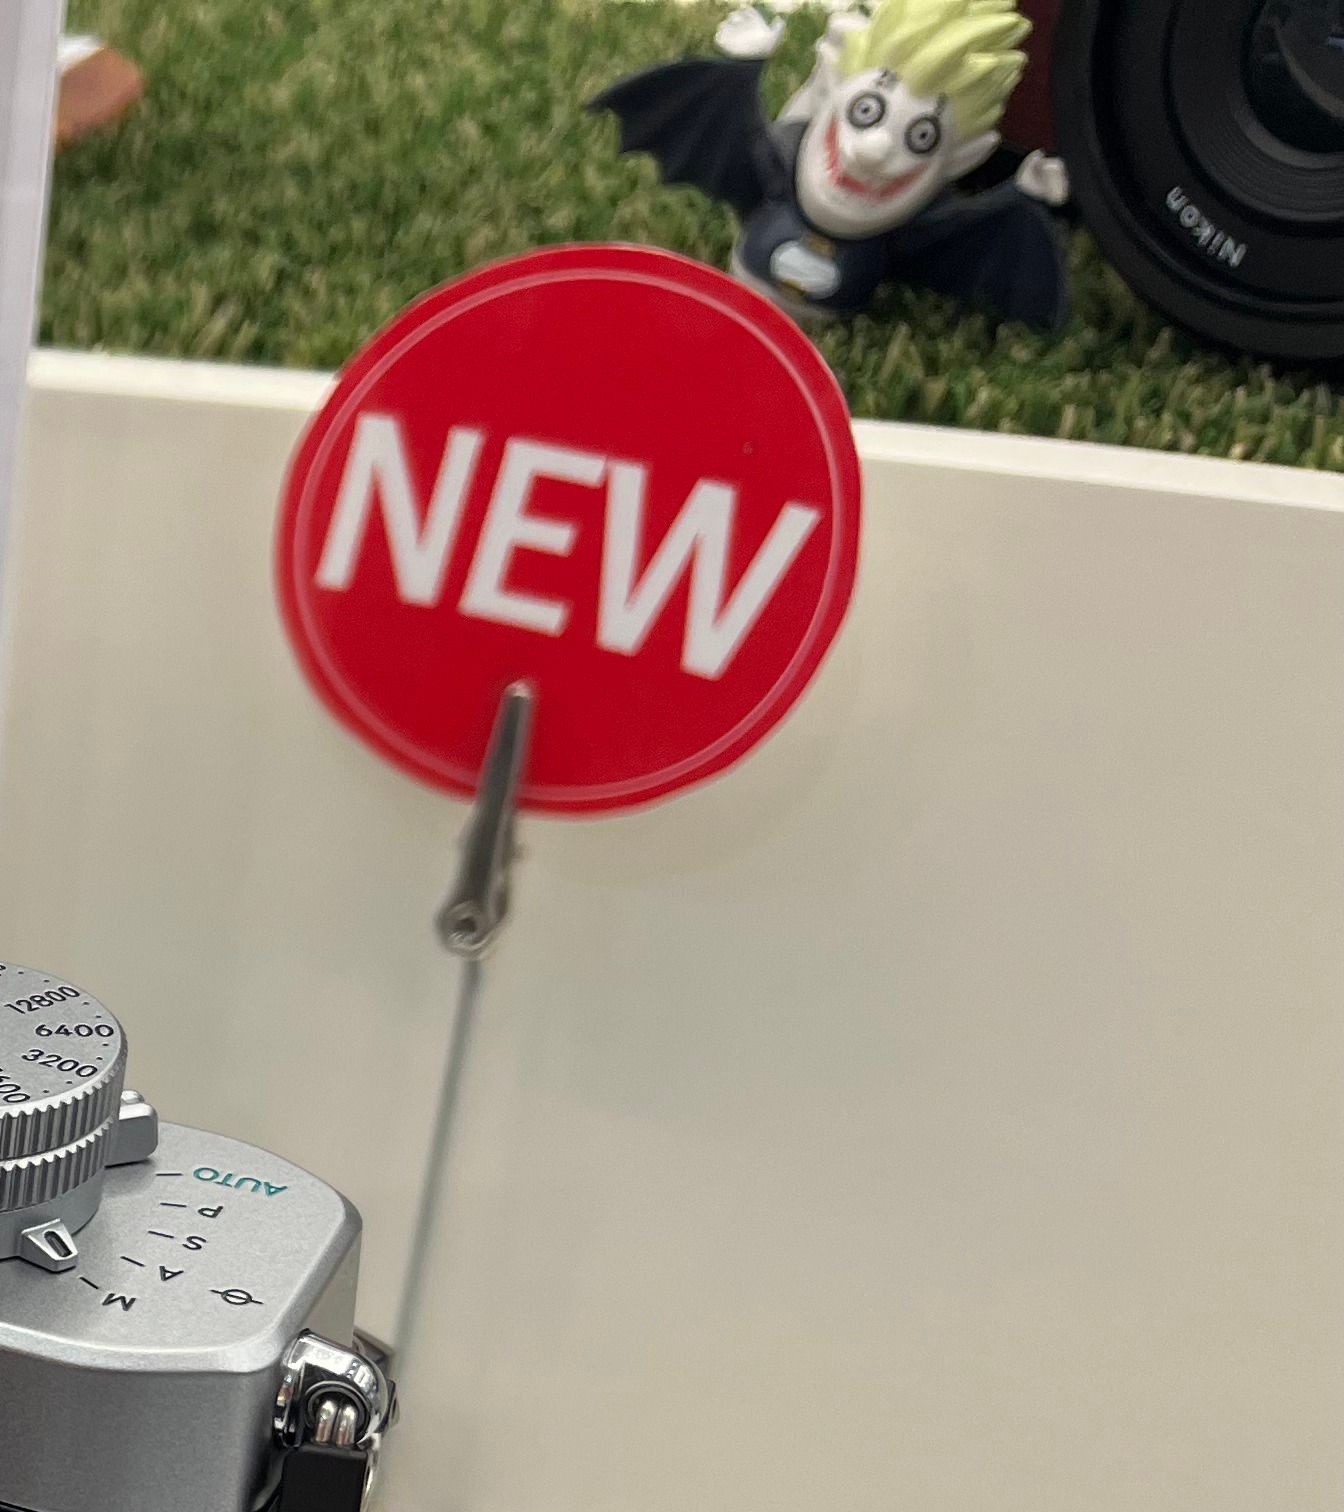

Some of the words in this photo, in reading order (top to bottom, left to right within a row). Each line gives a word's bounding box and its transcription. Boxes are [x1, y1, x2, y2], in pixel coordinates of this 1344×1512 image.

[1166, 186, 1247, 268] Nikon
[314, 411, 823, 682] NEW
[4, 985, 80, 1015] 12800
[35, 1023, 114, 1040] 6400
[21, 1049, 98, 1079] 3200
[192, 1166, 288, 1198] AUTO
[198, 1205, 224, 1219] P
[182, 1234, 208, 1251] S
[158, 1265, 184, 1282] A
[102, 1293, 136, 1312] M
